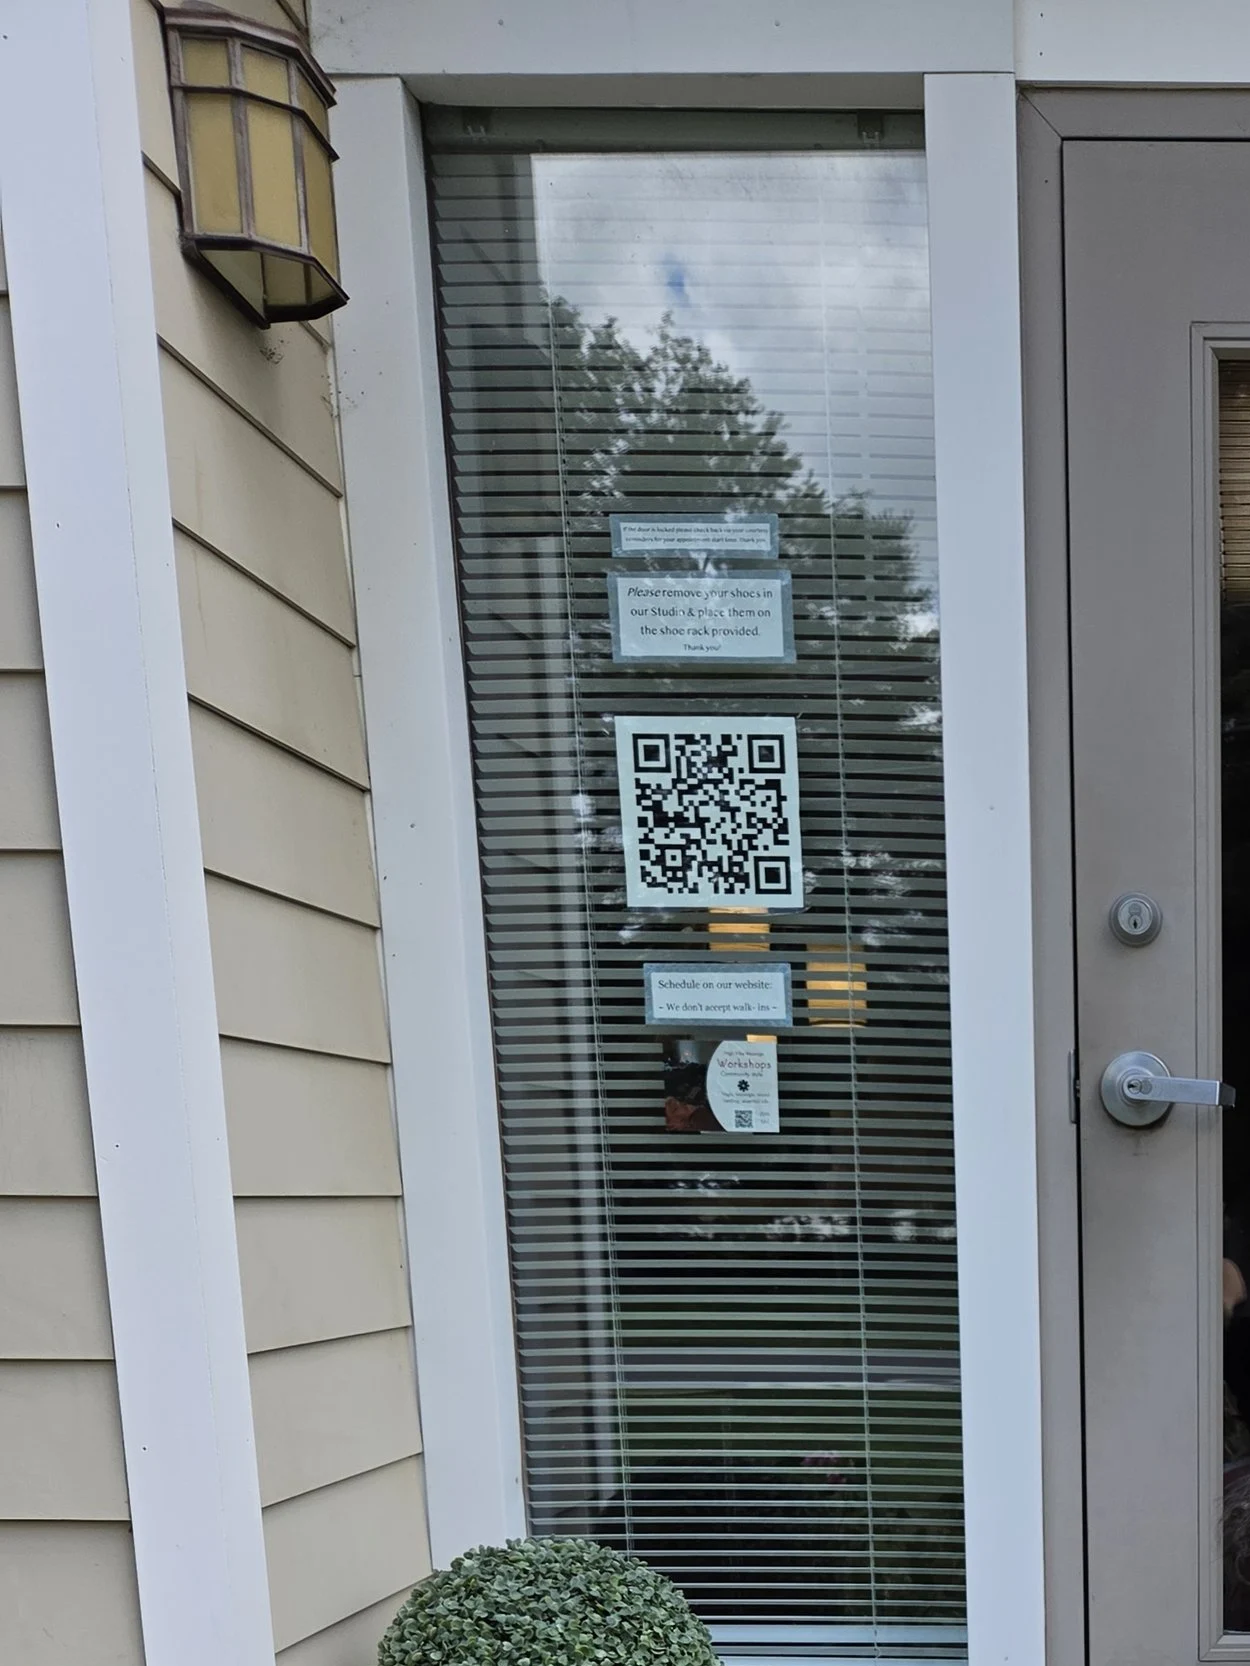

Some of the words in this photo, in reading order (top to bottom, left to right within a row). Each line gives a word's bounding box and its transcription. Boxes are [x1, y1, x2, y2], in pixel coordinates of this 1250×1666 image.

[627, 587, 661, 598] Please
[662, 589, 702, 598] remove
[703, 589, 728, 600] your
[730, 588, 761, 598] shoes
[763, 588, 773, 598] in
[630, 608, 648, 617] our
[650, 606, 686, 617] Studio
[687, 607, 696, 617] &
[698, 607, 725, 620] place
[728, 607, 756, 617] them
[757, 609, 771, 617] on
[640, 626, 658, 636] the
[659, 625, 685, 636] shoe
[687, 625, 710, 636] rack
[711, 626, 760, 637] provided.
[683, 643, 706, 651] Thank
[658, 979, 700, 990] Schedule
[702, 981, 714, 989] on
[716, 981, 732, 989] our
[666, 1003, 680, 1011] We
[681, 1002, 703, 1011] don't
[705, 1003, 731, 1013] accept
[716, 1058, 772, 1071] Workshops
